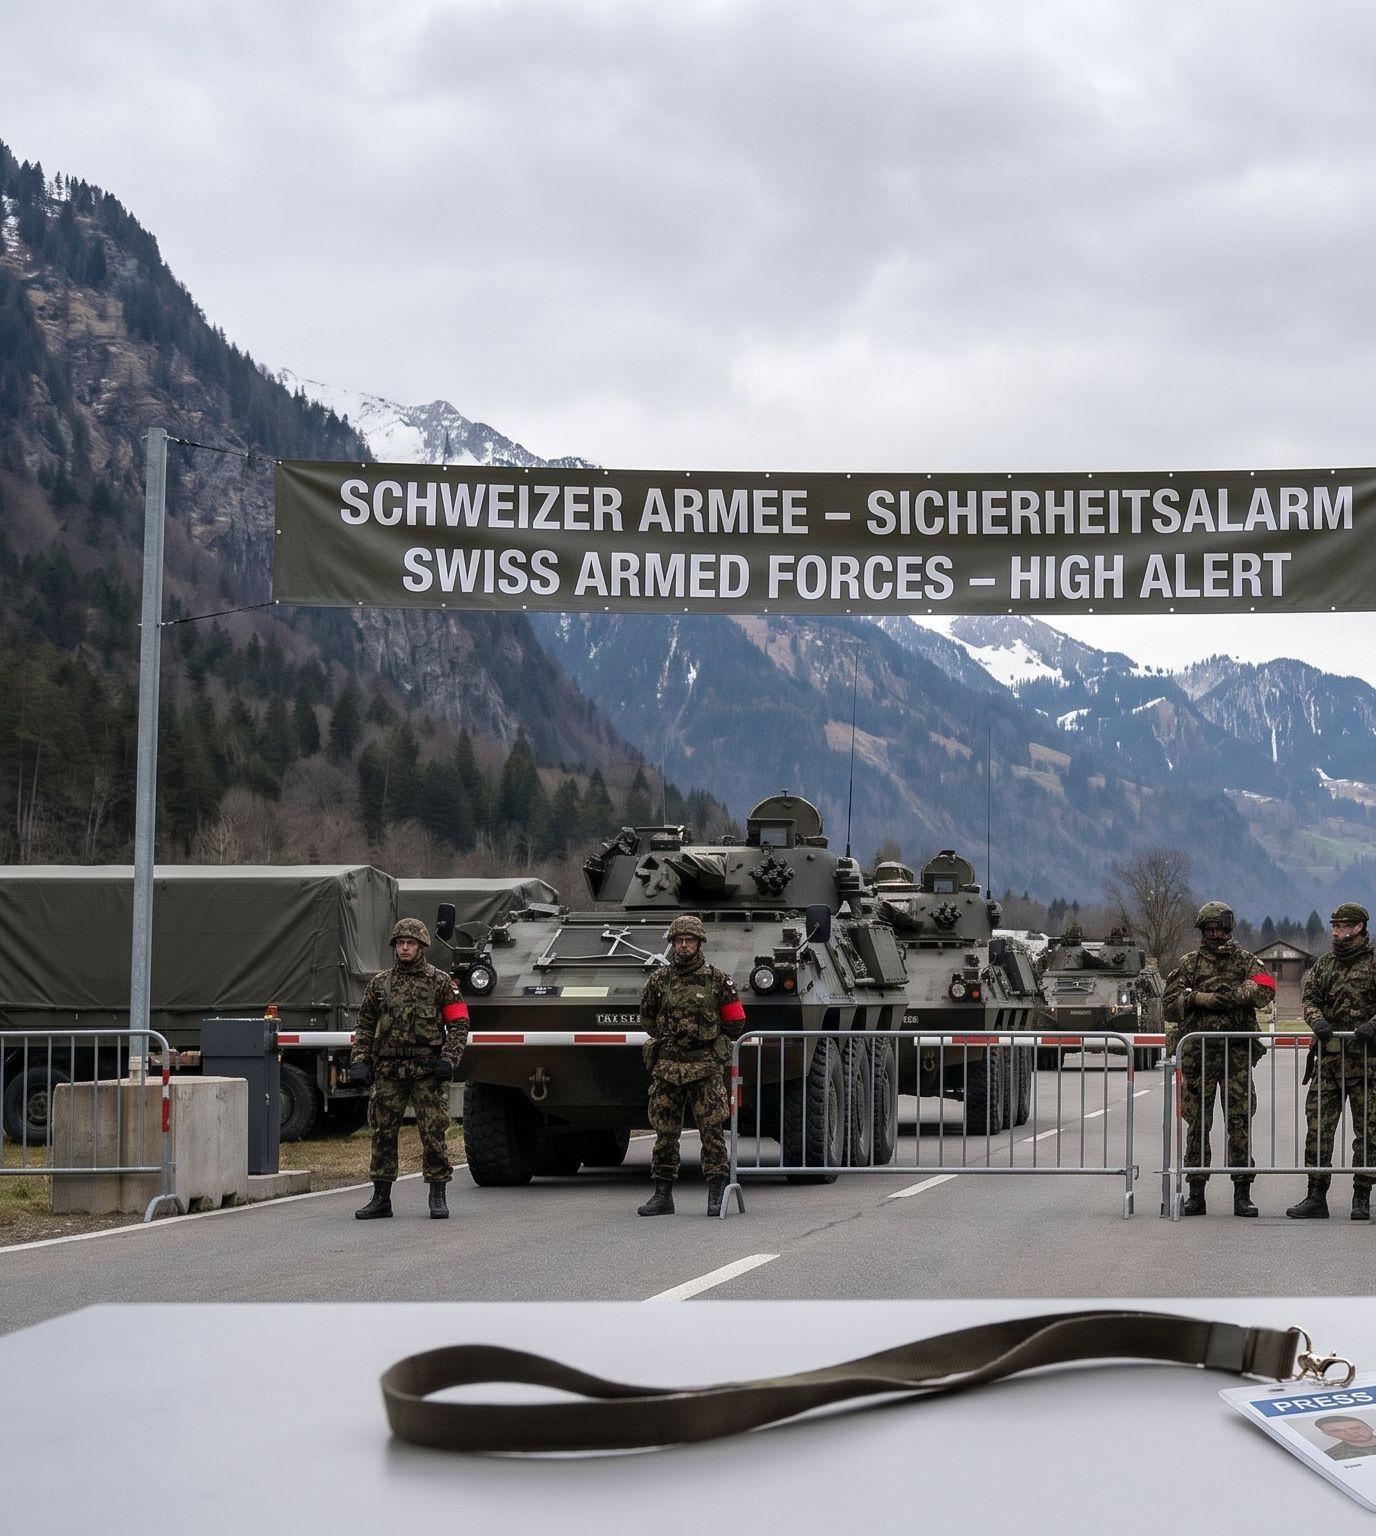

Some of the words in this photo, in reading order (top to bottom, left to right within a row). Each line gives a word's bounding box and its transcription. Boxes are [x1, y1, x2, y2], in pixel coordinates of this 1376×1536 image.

[340, 478, 624, 532] SCHWEIZER
[638, 487, 809, 534] ARMEE
[866, 485, 1353, 536] SICHERHEITSALARM
[402, 547, 560, 596] SWISS
[574, 551, 750, 598] ARMED
[768, 554, 954, 601] FORCES
[1010, 554, 1124, 600] HIGH
[1139, 552, 1292, 599] ALERT
[1272, 1391, 1374, 1412] PRESS
